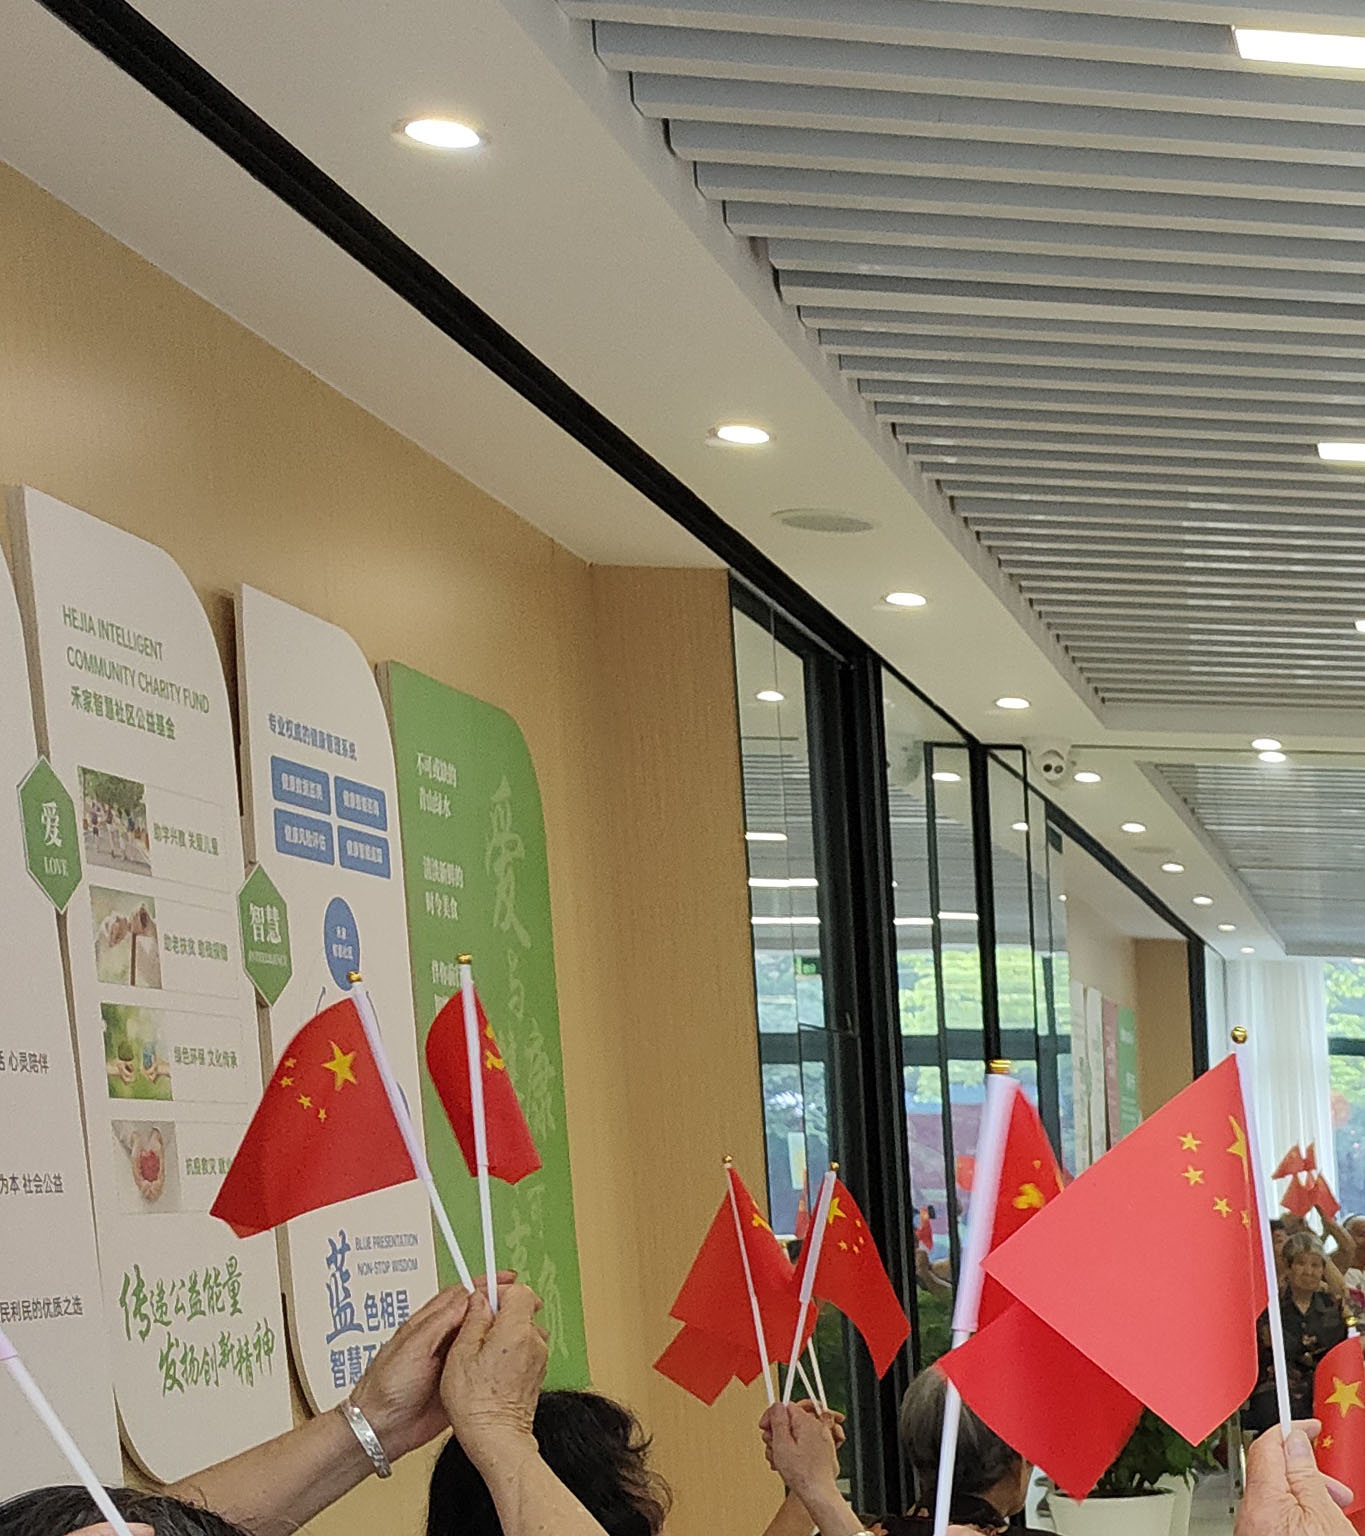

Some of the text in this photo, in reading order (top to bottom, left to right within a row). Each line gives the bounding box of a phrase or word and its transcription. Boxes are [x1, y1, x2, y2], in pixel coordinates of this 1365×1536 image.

[62, 604, 164, 662] HEJIA INTELLIGENT
[66, 646, 210, 714] COMMUNITY CHARITY FUND
[70, 685, 176, 741] 禾家智慧社区公益基金
[41, 801, 63, 848] 爱
[43, 855, 69, 878] LOVE
[249, 902, 282, 944] 智慧
[8, 1049, 50, 1074] 心灵陪伴
[22, 1172, 64, 1195] 社会公益
[354, 1233, 419, 1251] BLUE PRESENTATION
[357, 1257, 419, 1277] NON-STOP WISDOM
[0, 1295, 84, 1323] 民利民的优质之选
[119, 1255, 243, 1343] 传递公益能量
[158, 1317, 275, 1397] 发扬创新精神
[330, 1340, 389, 1389] 智慧不
